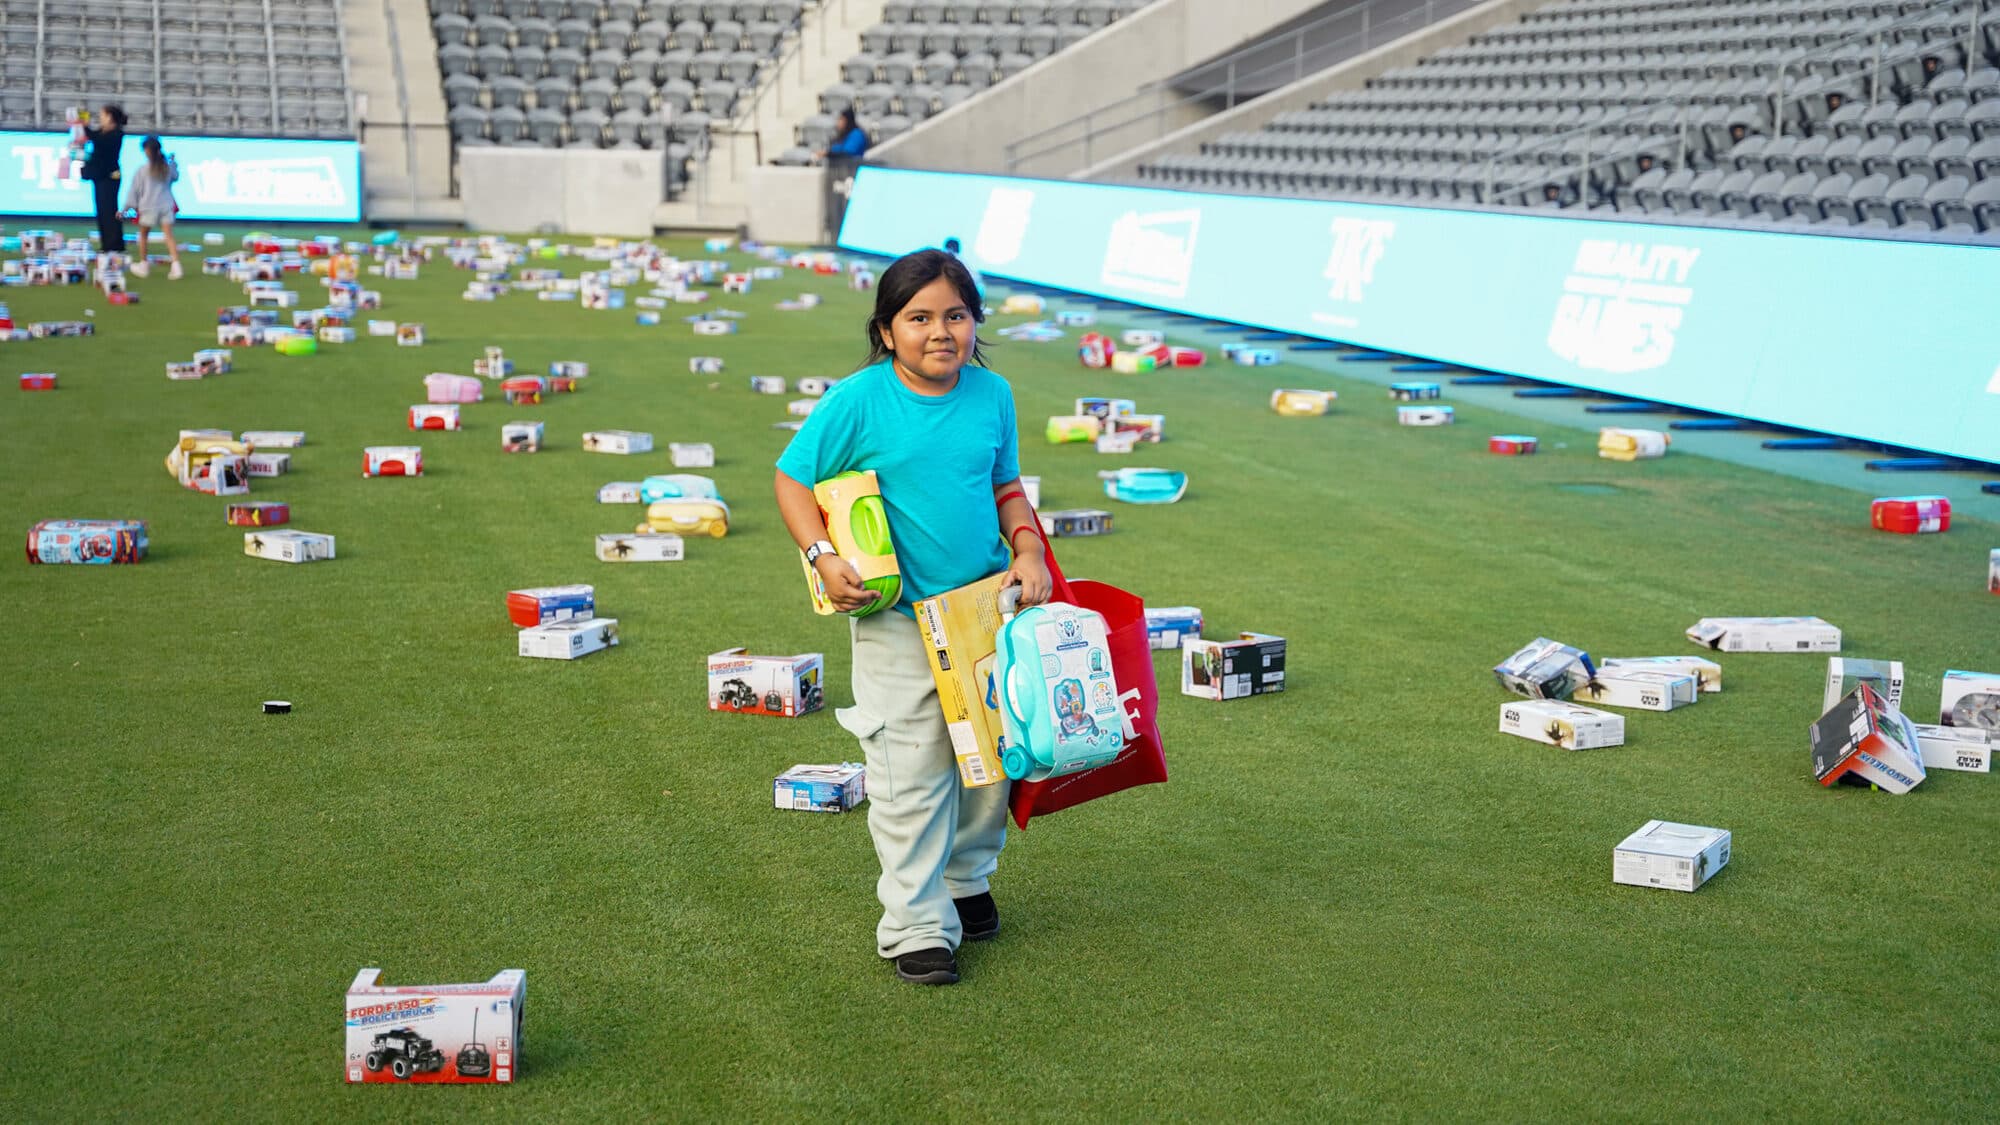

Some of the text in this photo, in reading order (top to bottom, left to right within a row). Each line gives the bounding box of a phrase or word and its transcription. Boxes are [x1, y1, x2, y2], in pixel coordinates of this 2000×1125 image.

[1956, 755, 1983, 763] WARS
[1860, 752, 1915, 787] REVO HELIX
[352, 1000, 418, 1018] FORD F-150
[362, 1012, 396, 1025] POLICE
[400, 1004, 435, 1018] TRUCK
